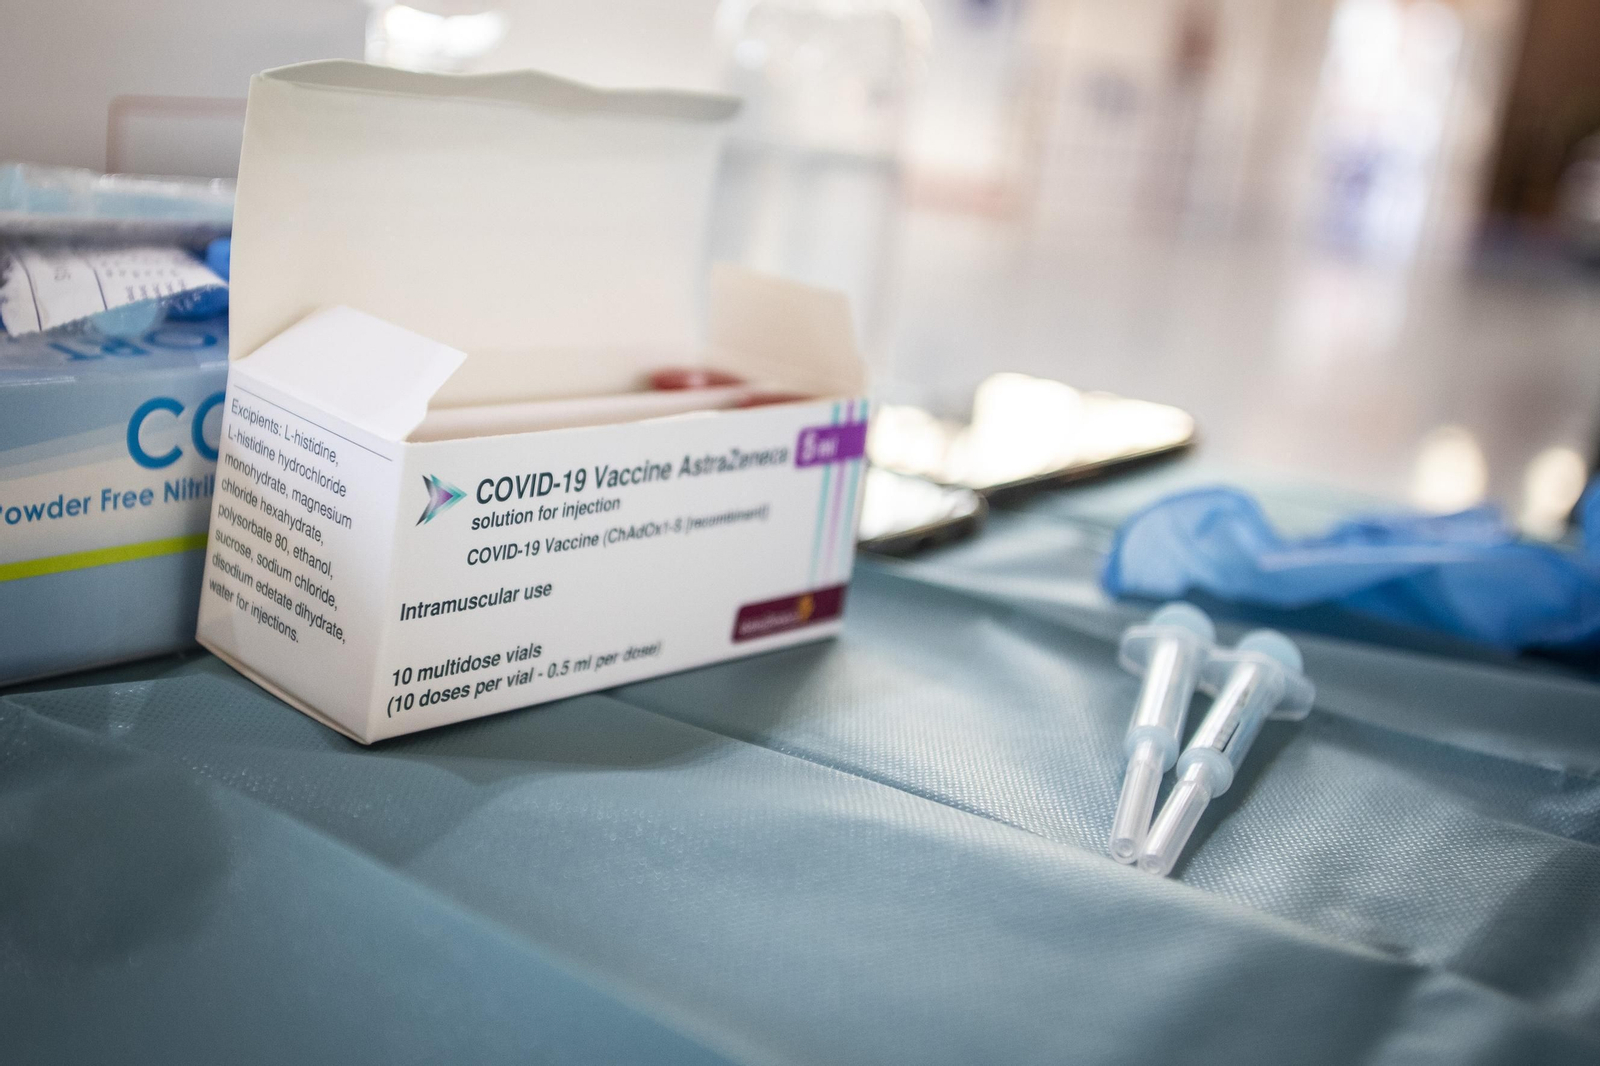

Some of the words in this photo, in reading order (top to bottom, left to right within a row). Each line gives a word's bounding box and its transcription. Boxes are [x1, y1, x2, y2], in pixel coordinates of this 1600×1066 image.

[228, 424, 275, 461] L-histidine
[277, 448, 347, 498] hydrochloride
[231, 398, 283, 436] Excipients:
[284, 423, 339, 467] L-histidine,
[0, 494, 91, 525] owder
[101, 487, 154, 512] Free
[225, 452, 288, 499] monohydrate,
[291, 487, 352, 530] magnesium
[475, 467, 587, 505] COVID-19
[594, 456, 673, 489] Vaccine
[678, 446, 790, 477] AstraZeneca
[218, 503, 272, 545] polysorbate
[274, 531, 290, 556] 80,
[293, 546, 333, 581] ethanol,
[221, 476, 258, 508] chloride
[260, 496, 324, 546] hexahydrate,
[471, 510, 533, 530] solution
[537, 504, 558, 521] for
[561, 497, 621, 520] injection
[215, 529, 253, 563] sucrose,
[256, 551, 292, 582] sodium
[294, 574, 338, 611] chloride,
[466, 540, 540, 566] COVID-19
[544, 533, 600, 553] Vaccine
[209, 577, 234, 602] water
[235, 592, 250, 612] for
[251, 604, 299, 643] injections.
[212, 551, 254, 586] disodium
[255, 580, 293, 611] edetate
[294, 603, 346, 645] dihydrate,
[399, 587, 519, 621] Intramuscular
[523, 582, 552, 601] use
[386, 691, 414, 718] (10
[418, 681, 470, 707] doses
[474, 675, 502, 699] per
[506, 667, 533, 688] vial
[547, 660, 570, 679] 0.5
[573, 655, 592, 673] ml
[594, 652, 618, 672] per
[622, 640, 663, 662] dose)
[392, 667, 412, 687] 10
[416, 653, 501, 682] multidose
[505, 643, 542, 663] vials
